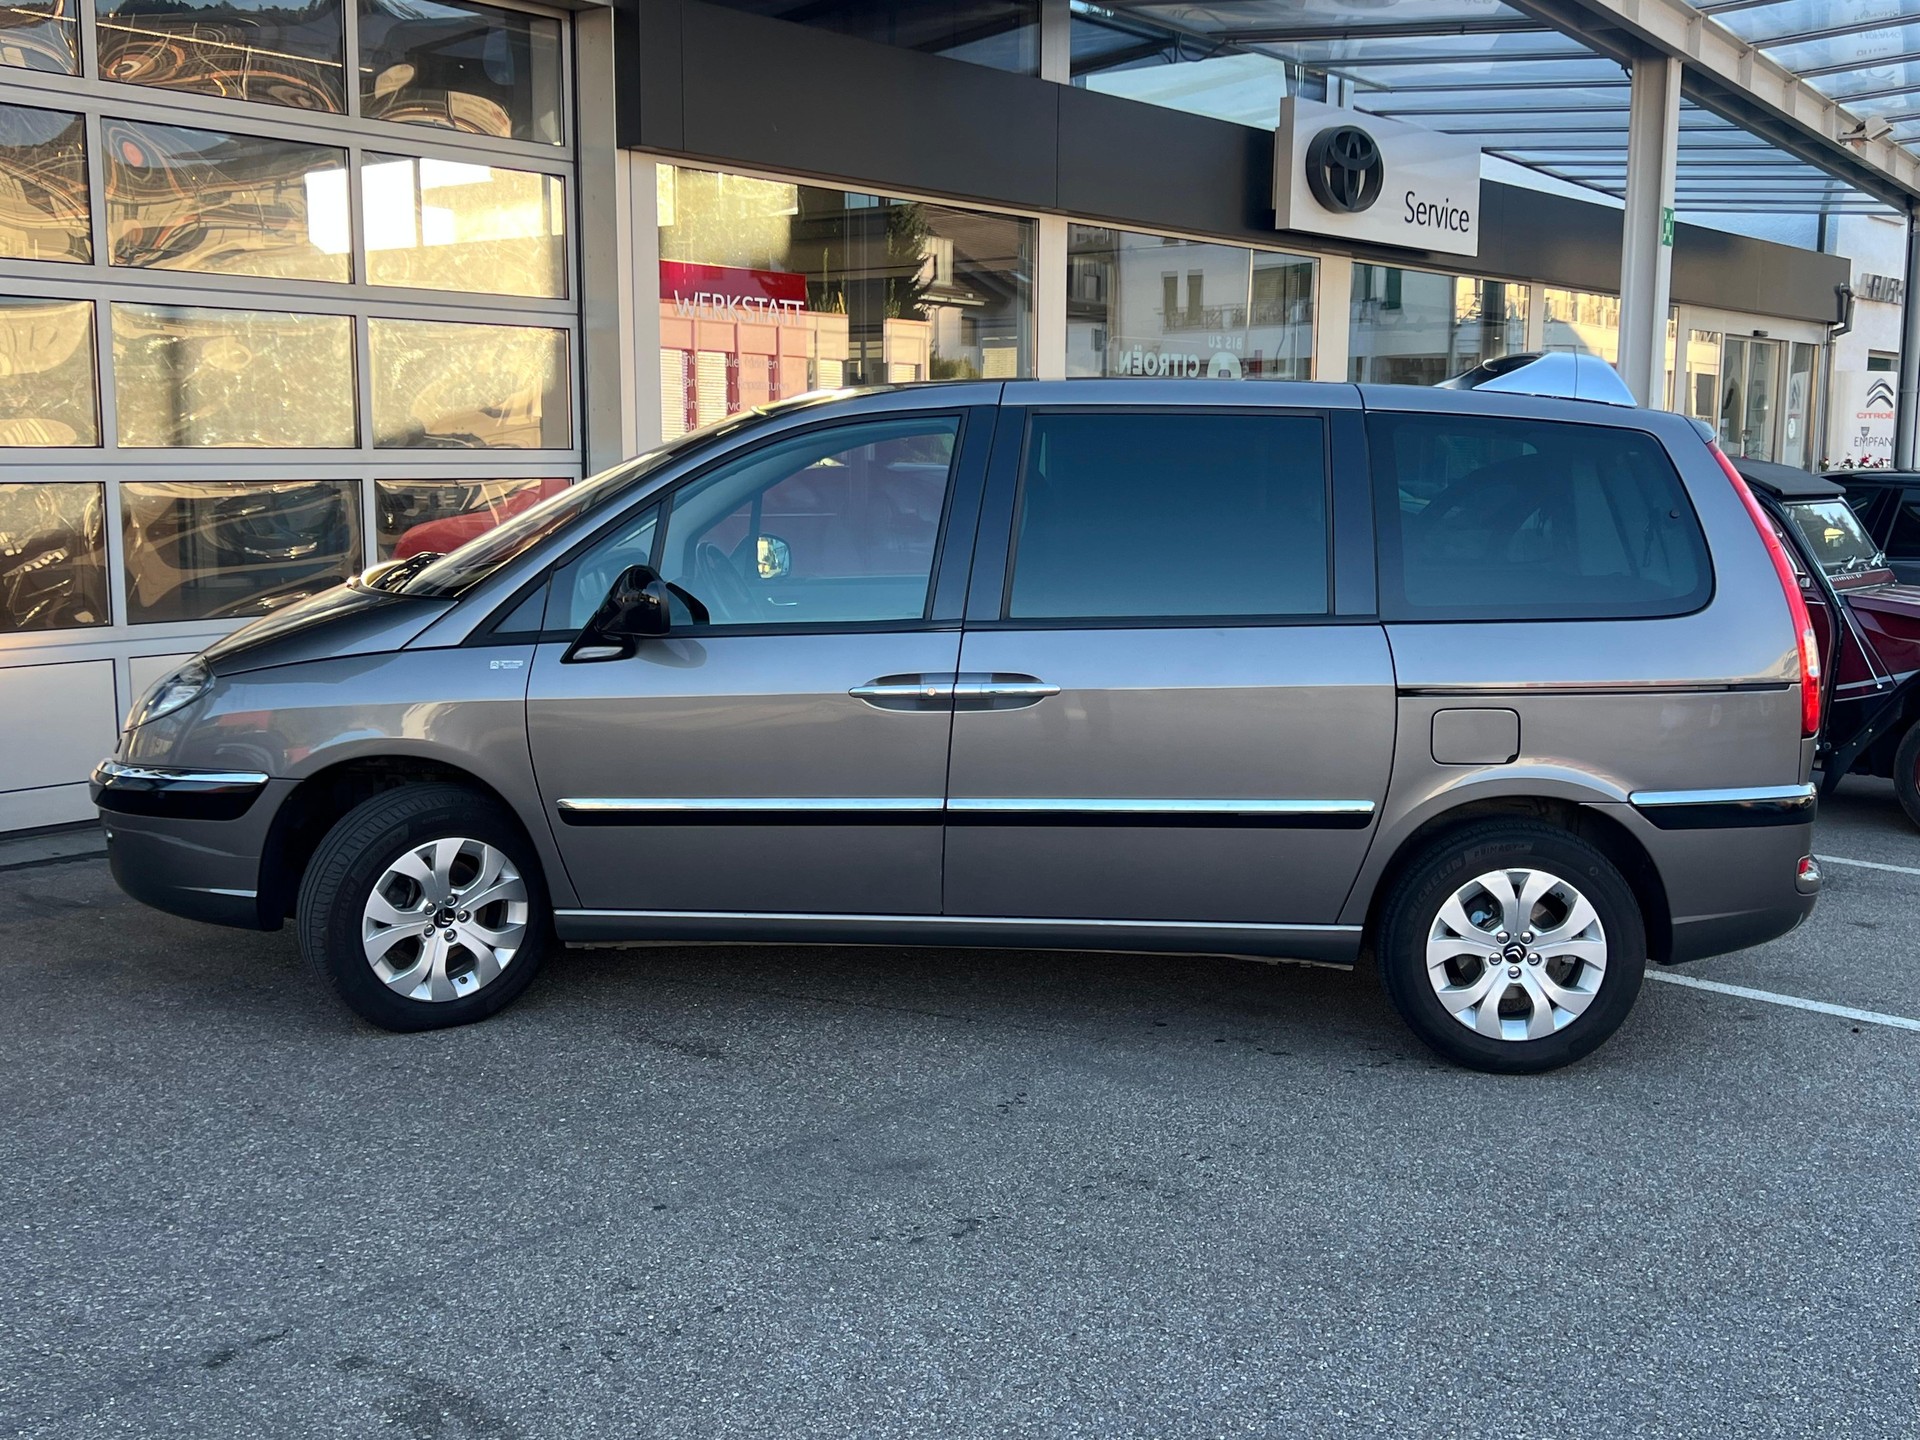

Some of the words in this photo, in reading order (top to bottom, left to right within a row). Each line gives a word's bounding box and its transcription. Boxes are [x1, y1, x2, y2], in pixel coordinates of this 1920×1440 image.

[1404, 191, 1470, 233] Service
[674, 289, 804, 325] WERKSTATT
[1856, 411, 1894, 420] CITROË
[1854, 436, 1893, 447] EMPFAN
